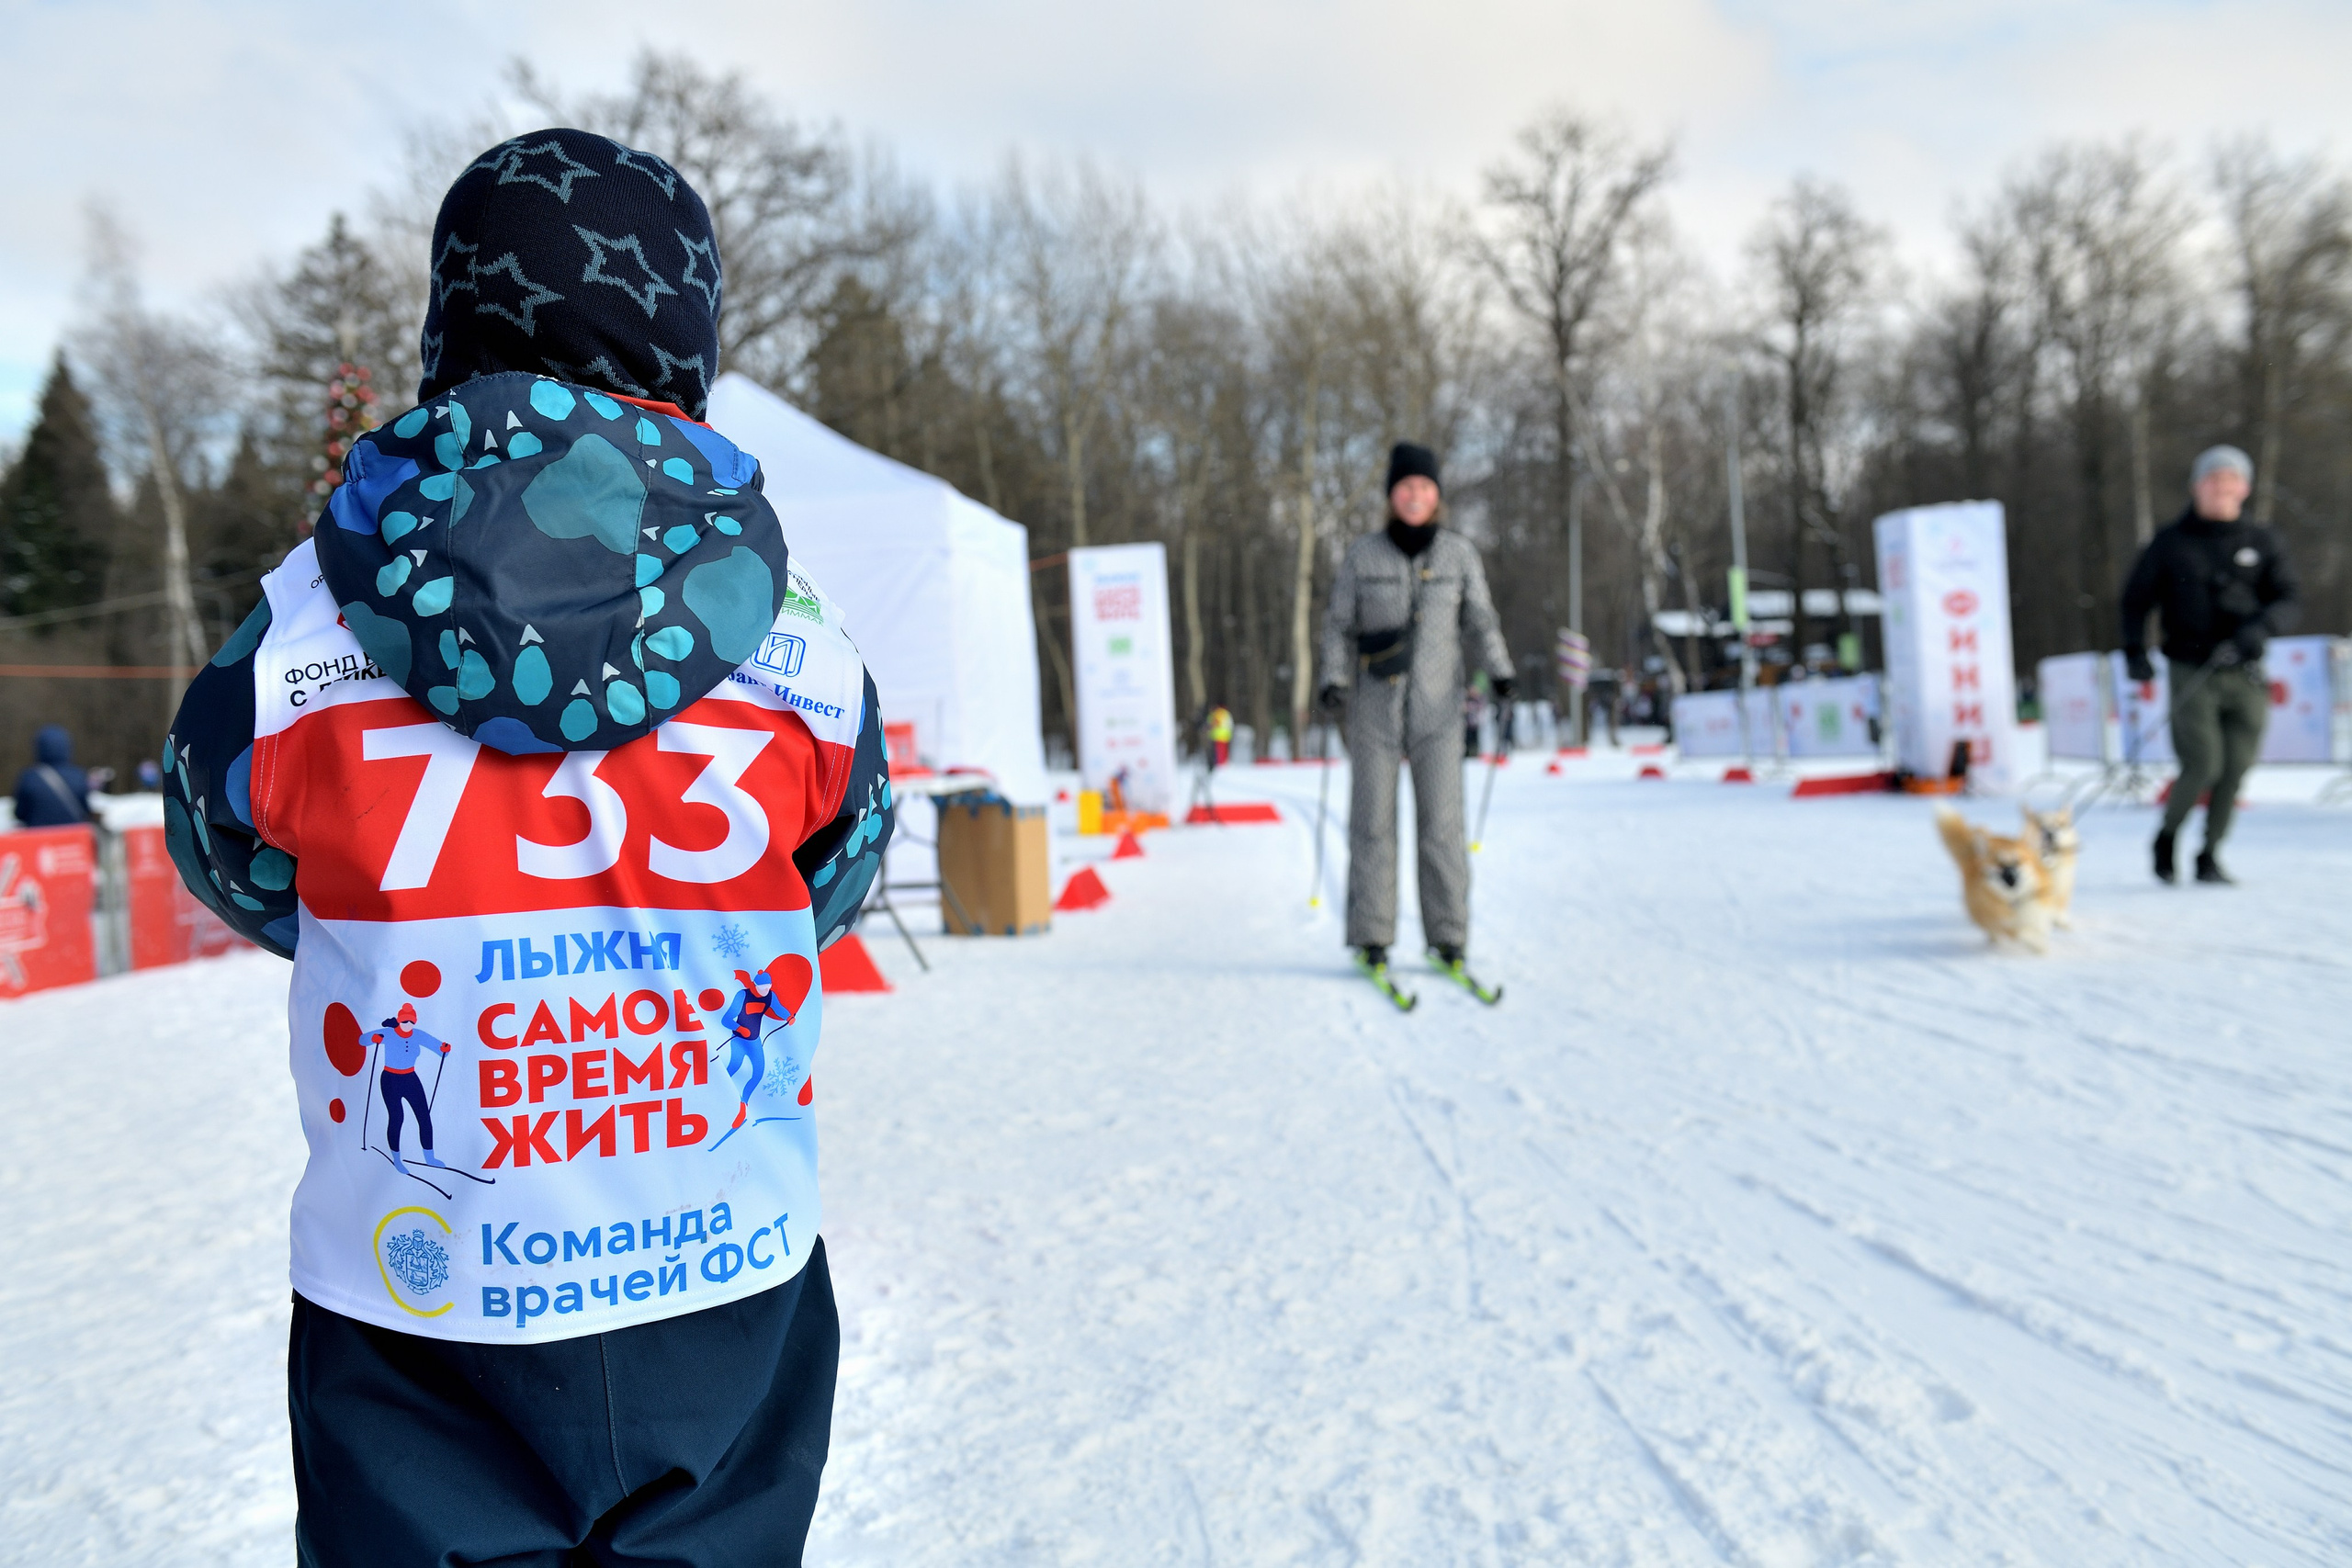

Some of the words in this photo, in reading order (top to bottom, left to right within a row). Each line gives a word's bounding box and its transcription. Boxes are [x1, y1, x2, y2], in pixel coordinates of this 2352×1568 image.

[285, 654, 359, 685] ФОНД
[289, 690, 308, 707] С
[362, 722, 775, 892] 733
[475, 931, 682, 984] ЛЫЖНЯ
[477, 988, 705, 1050] САМОЕ
[479, 1039, 708, 1108] ВРЕМЯ
[480, 1097, 708, 1169] ЖИТЬ
[481, 1201, 733, 1265] Команда
[482, 1253, 687, 1328] врачей
[700, 1213, 791, 1283] ФСТ
